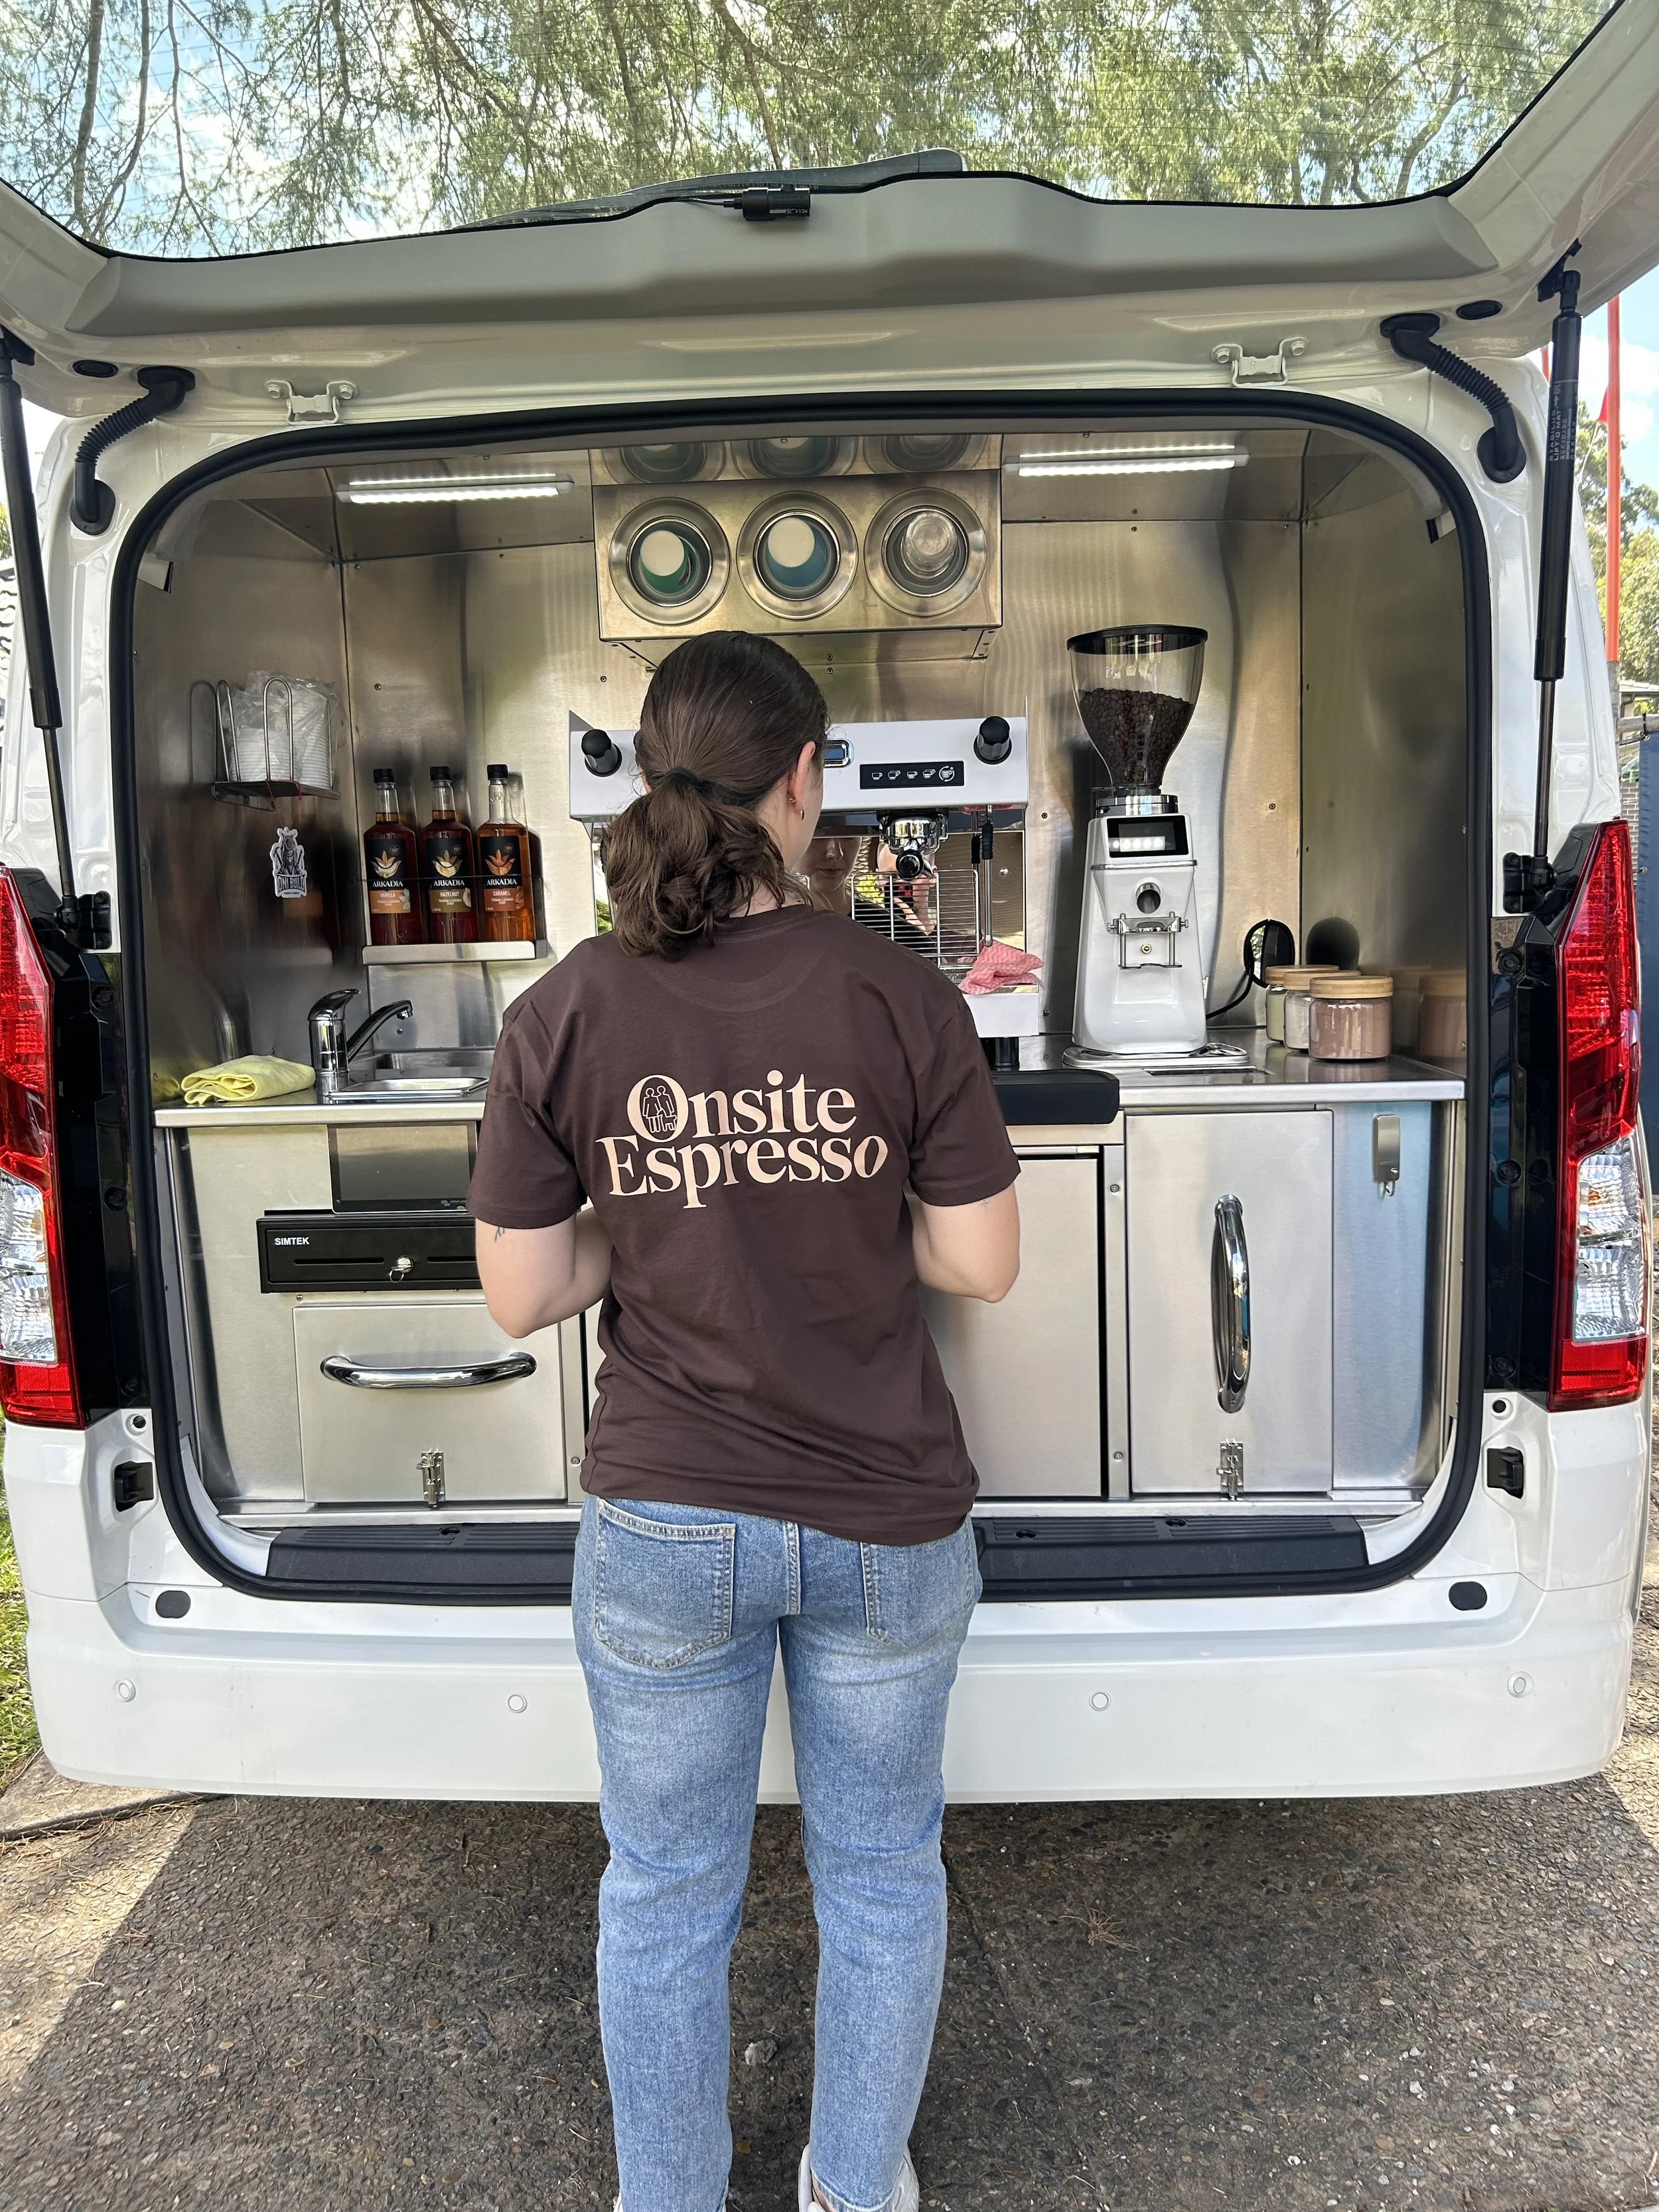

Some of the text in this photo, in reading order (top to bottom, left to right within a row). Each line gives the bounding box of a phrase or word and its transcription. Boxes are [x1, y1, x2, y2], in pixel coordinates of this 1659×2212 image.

[289, 876, 305, 891] BUILD
[626, 1069, 858, 1143] Onsite
[596, 1135, 889, 1209] Espresso
[275, 1237, 310, 1246] SIMTEK
